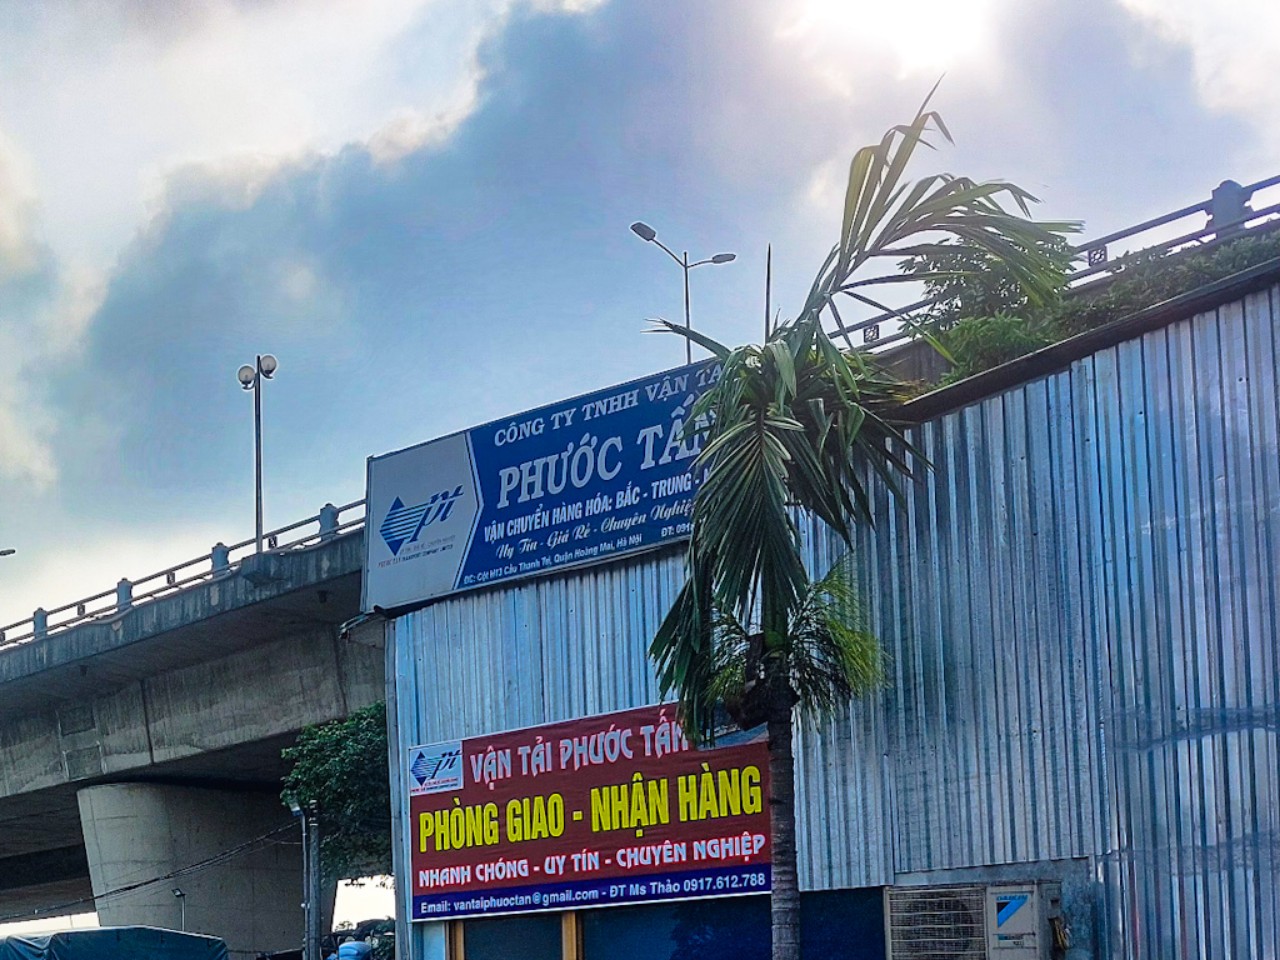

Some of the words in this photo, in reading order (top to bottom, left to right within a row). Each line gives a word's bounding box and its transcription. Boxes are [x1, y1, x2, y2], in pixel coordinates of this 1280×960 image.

[494, 421, 545, 447] CÔNG
[550, 408, 577, 430] TY
[581, 389, 639, 421] TNHH
[645, 373, 690, 403] VẬN
[496, 432, 622, 510] PHƯỚC
[484, 520, 505, 544] VẬN
[506, 505, 550, 537] CHUYỂN
[551, 499, 583, 527] HÀNG
[585, 492, 613, 517] HÓA:
[615, 481, 641, 509] BẮC
[650, 473, 692, 499] TRUNG
[518, 538, 538, 554] Tín
[547, 529, 570, 549] Giá
[600, 512, 647, 534] Chuyên
[518, 560, 540, 572] Thanh
[469, 745, 511, 791] VẬN
[517, 735, 553, 777] TẢI
[559, 724, 634, 771] PHƯỚC
[419, 797, 499, 853] PHÒNG
[506, 793, 565, 846] GIAO
[590, 771, 670, 838] NHẬN
[677, 762, 762, 823] HÀNG
[419, 865, 471, 889] NHANH
[475, 857, 529, 883] CHÓNG
[544, 855, 567, 876] UY
[571, 848, 600, 872] TÍN
[616, 839, 687, 869] CHUYÊN
[693, 831, 766, 862] NGHIỆP
[420, 900, 451, 914] Email:
[453, 889, 599, 912] vantaiphuoctan@gmail.com
[609, 884, 627, 898] ĐT
[629, 883, 647, 896] Ms
[649, 878, 681, 894] Thảo
[683, 872, 766, 892] 0917.612.788
